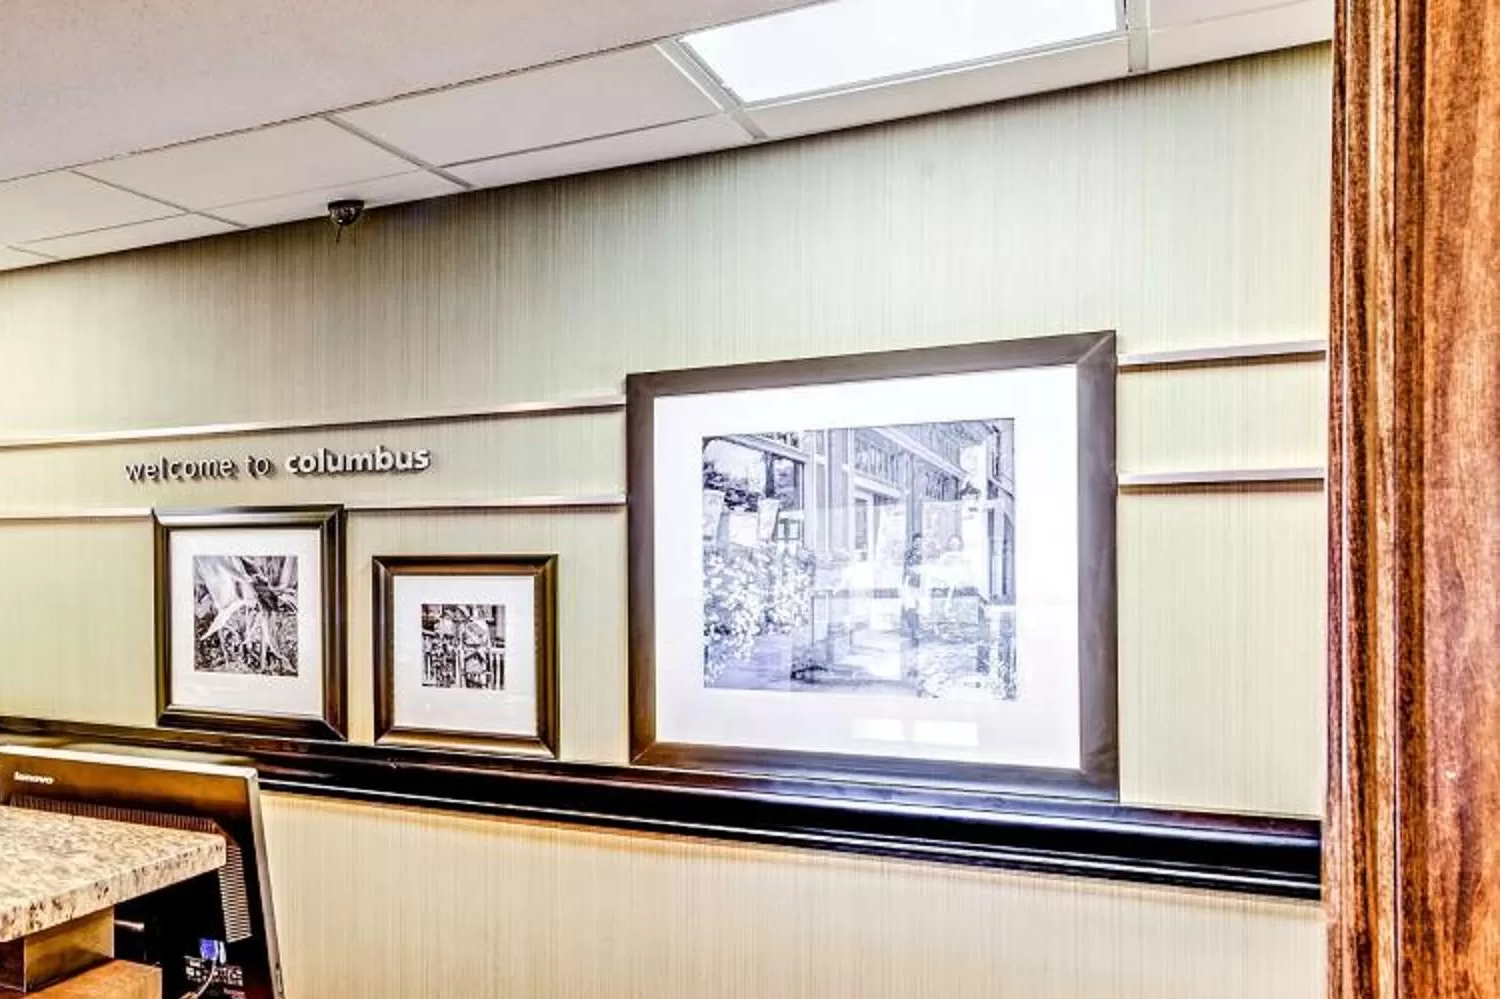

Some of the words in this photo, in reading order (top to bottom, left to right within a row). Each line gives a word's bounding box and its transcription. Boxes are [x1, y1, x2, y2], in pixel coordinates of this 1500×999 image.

[125, 457, 236, 481] welcome
[244, 455, 273, 478] to
[284, 445, 431, 475] columbus
